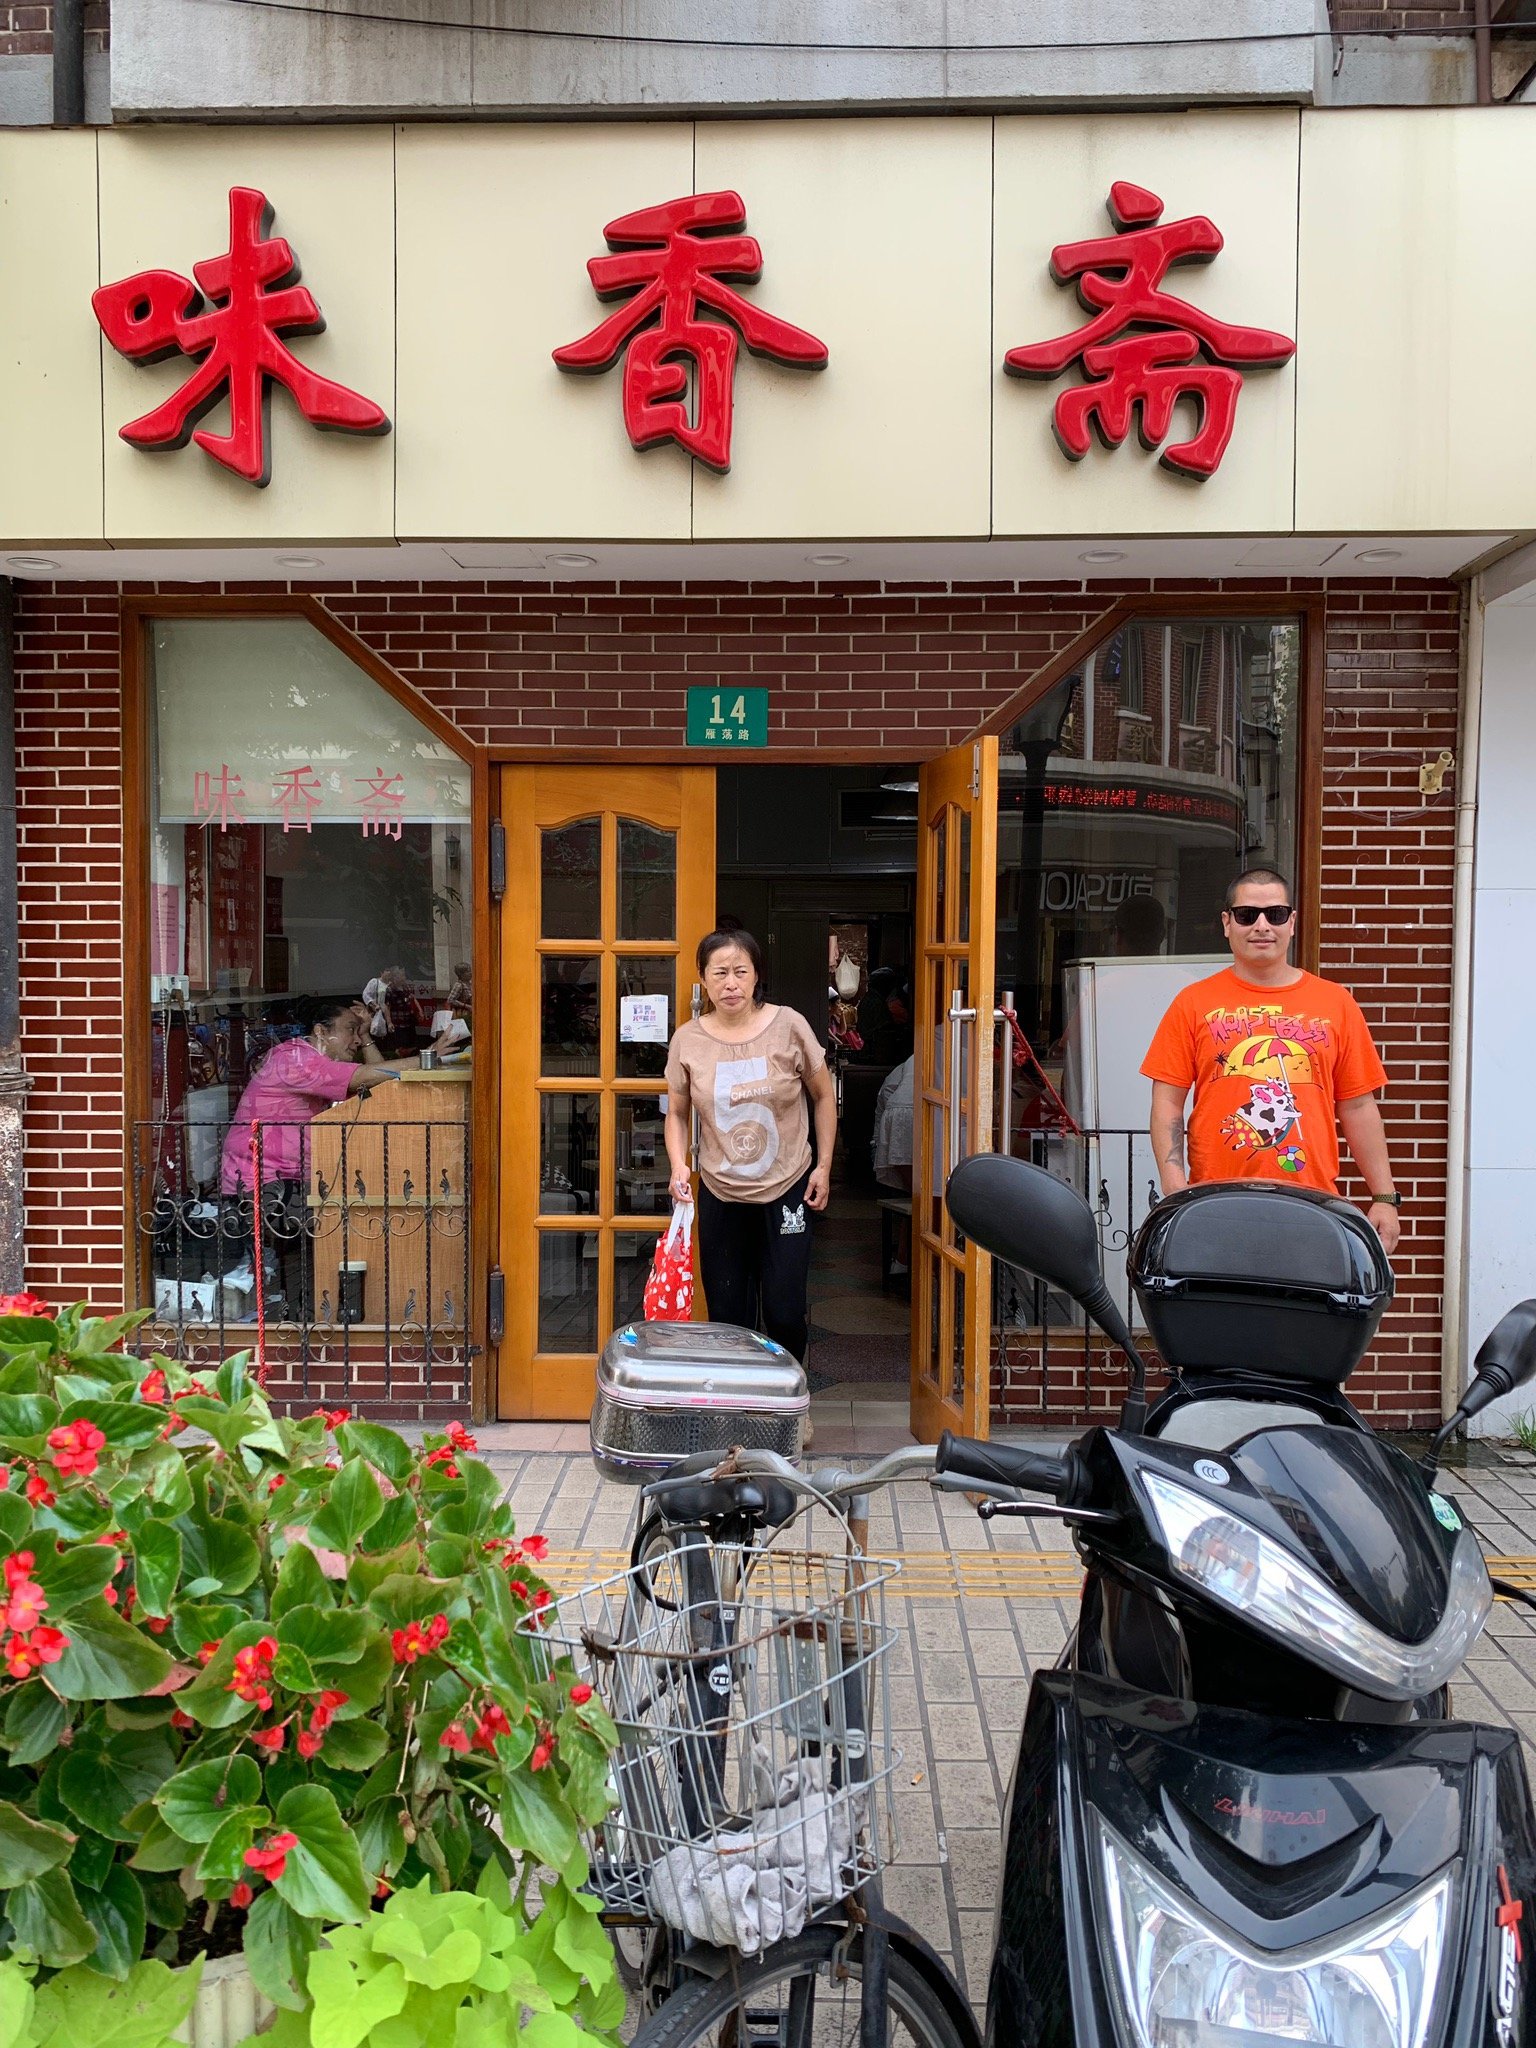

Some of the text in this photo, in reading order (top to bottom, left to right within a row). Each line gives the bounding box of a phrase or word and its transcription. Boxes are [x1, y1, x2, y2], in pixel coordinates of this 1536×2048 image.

[92, 180, 1297, 488] 味香斋
[709, 694, 746, 725] 14
[705, 728, 750, 741] 雁荡路
[192, 762, 407, 842] 味香斋
[1203, 1004, 1284, 1045] ROAST
[730, 1084, 776, 1101] CHANEL
[713, 1055, 780, 1180] 5
